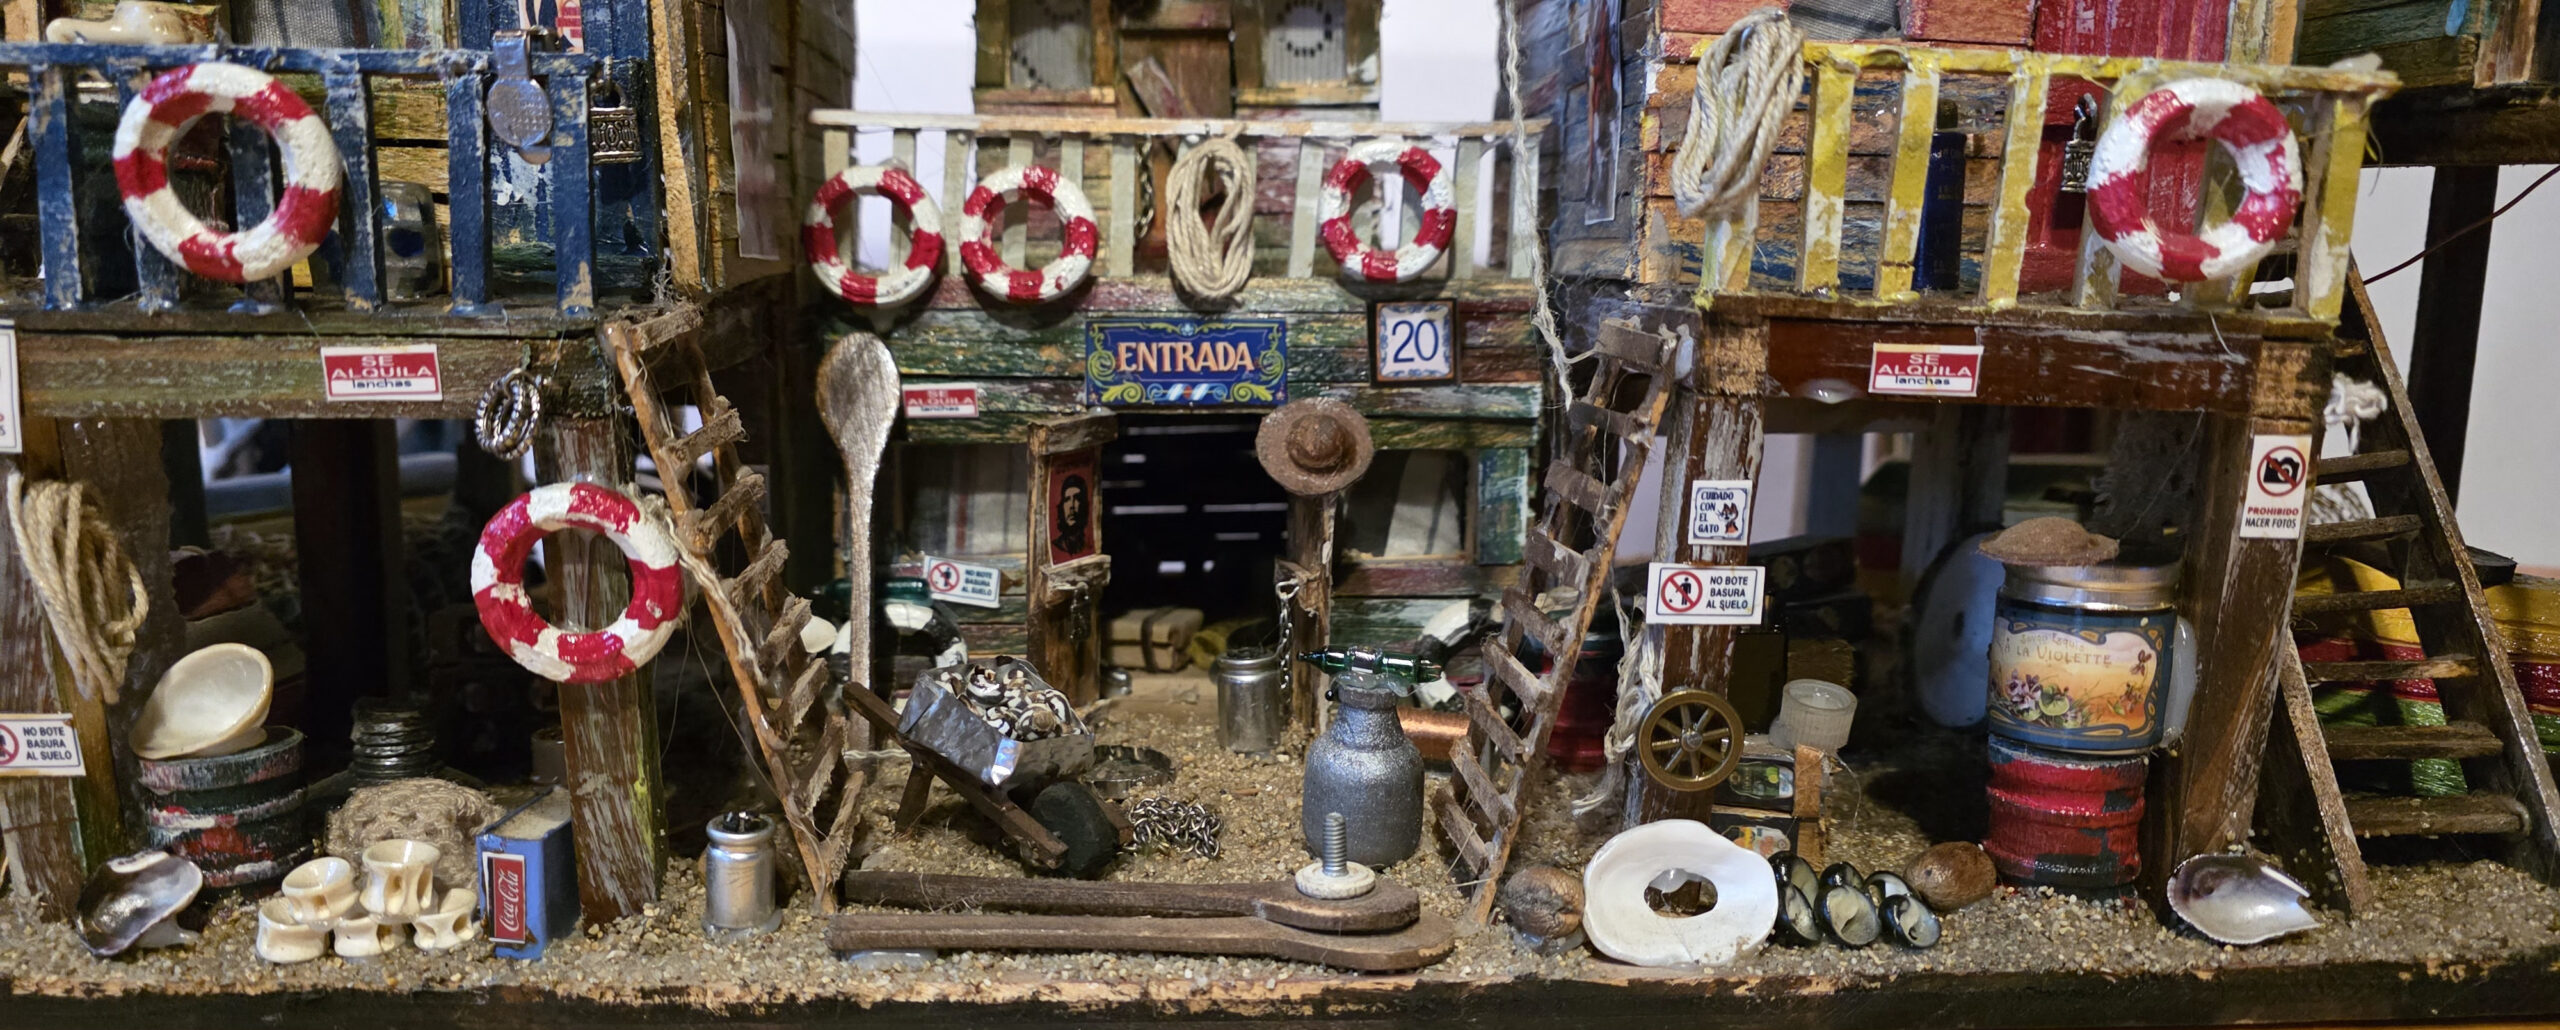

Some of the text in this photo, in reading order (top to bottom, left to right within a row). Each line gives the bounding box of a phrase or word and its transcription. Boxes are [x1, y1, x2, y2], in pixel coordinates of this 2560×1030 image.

[1392, 319, 1439, 363] 20
[361, 354, 394, 367] SE
[1117, 341, 1256, 373] ENTRADA
[1909, 353, 1940, 365] SE
[332, 366, 433, 379] ALQUILA
[1878, 364, 1972, 377] ALQUILA
[352, 378, 412, 389] lanchas
[1895, 375, 1950, 385] lanchas
[908, 397, 974, 406] ALQUILA
[1701, 491, 1734, 500] CUIDADO
[1700, 502, 1716, 511] CON
[2247, 506, 2299, 516] PROHIBIDO
[1699, 512, 1708, 522] EL
[2245, 517, 2297, 528] HACER FOTOS
[1698, 524, 1719, 533] GATO
[1710, 576, 1748, 586] NO BOTE
[1710, 588, 1745, 597] BASURA
[1706, 600, 1748, 610] AL SUELO
[2017, 647, 2030, 657] LA
[2037, 645, 2112, 665] VIOLETTE
[23, 727, 65, 736] NO BOTE
[27, 739, 66, 748] BASURA
[26, 750, 72, 760] AL SUELO
